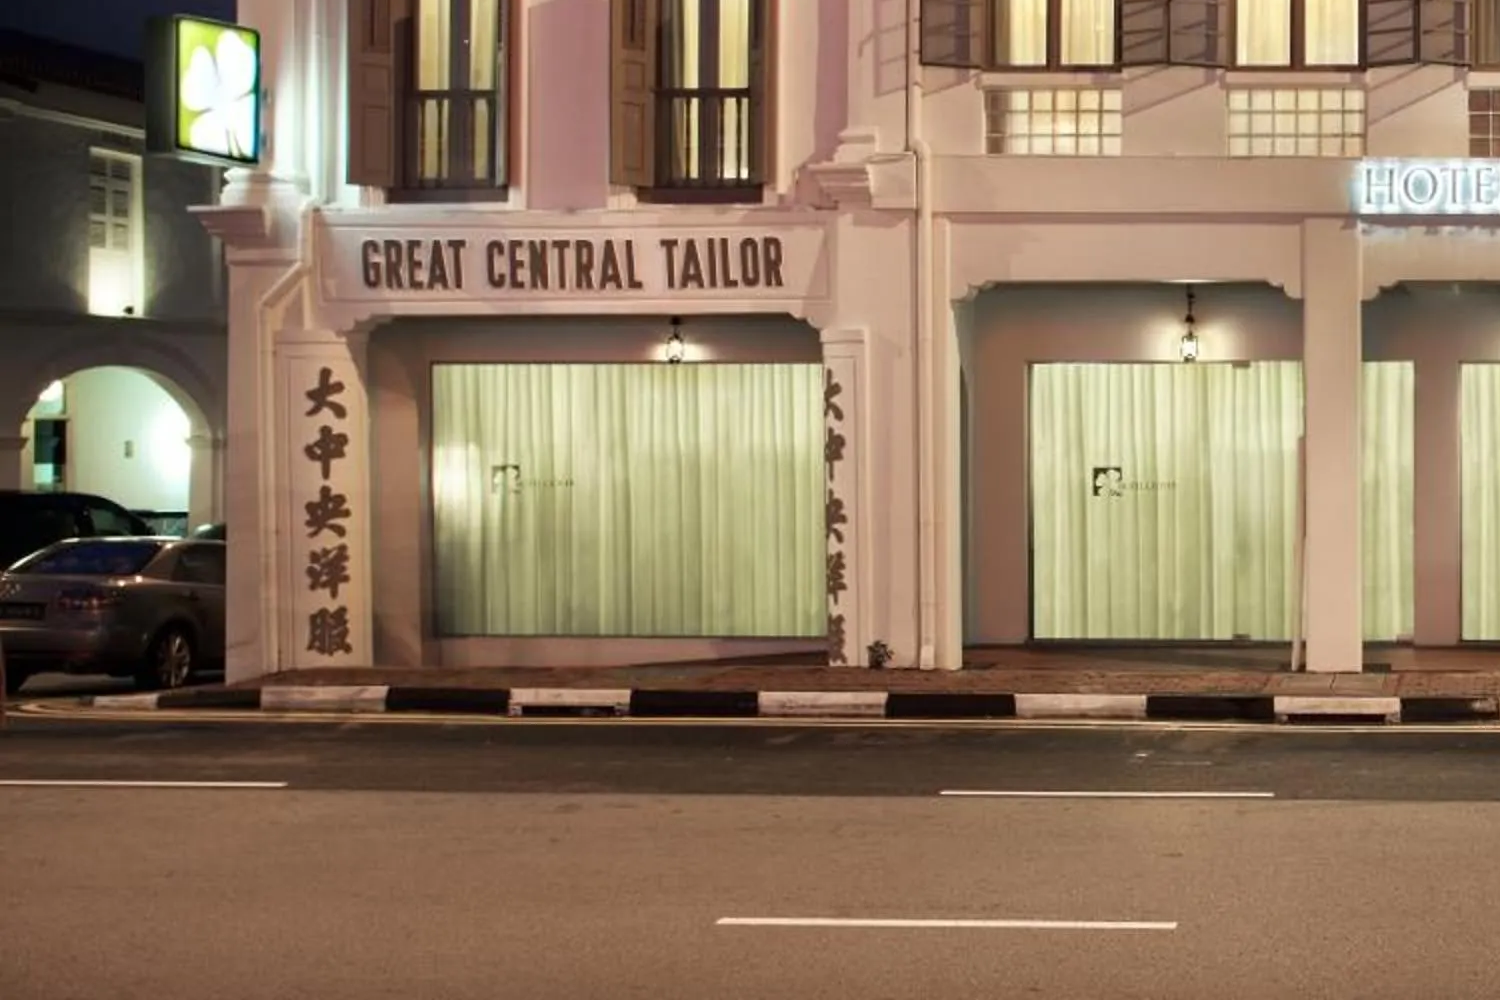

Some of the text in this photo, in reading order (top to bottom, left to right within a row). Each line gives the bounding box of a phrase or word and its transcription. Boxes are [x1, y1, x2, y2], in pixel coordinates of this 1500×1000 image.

[361, 236, 784, 291] GREAT CENTRAL TAILOR
[304, 367, 352, 657] 大中央洋服
